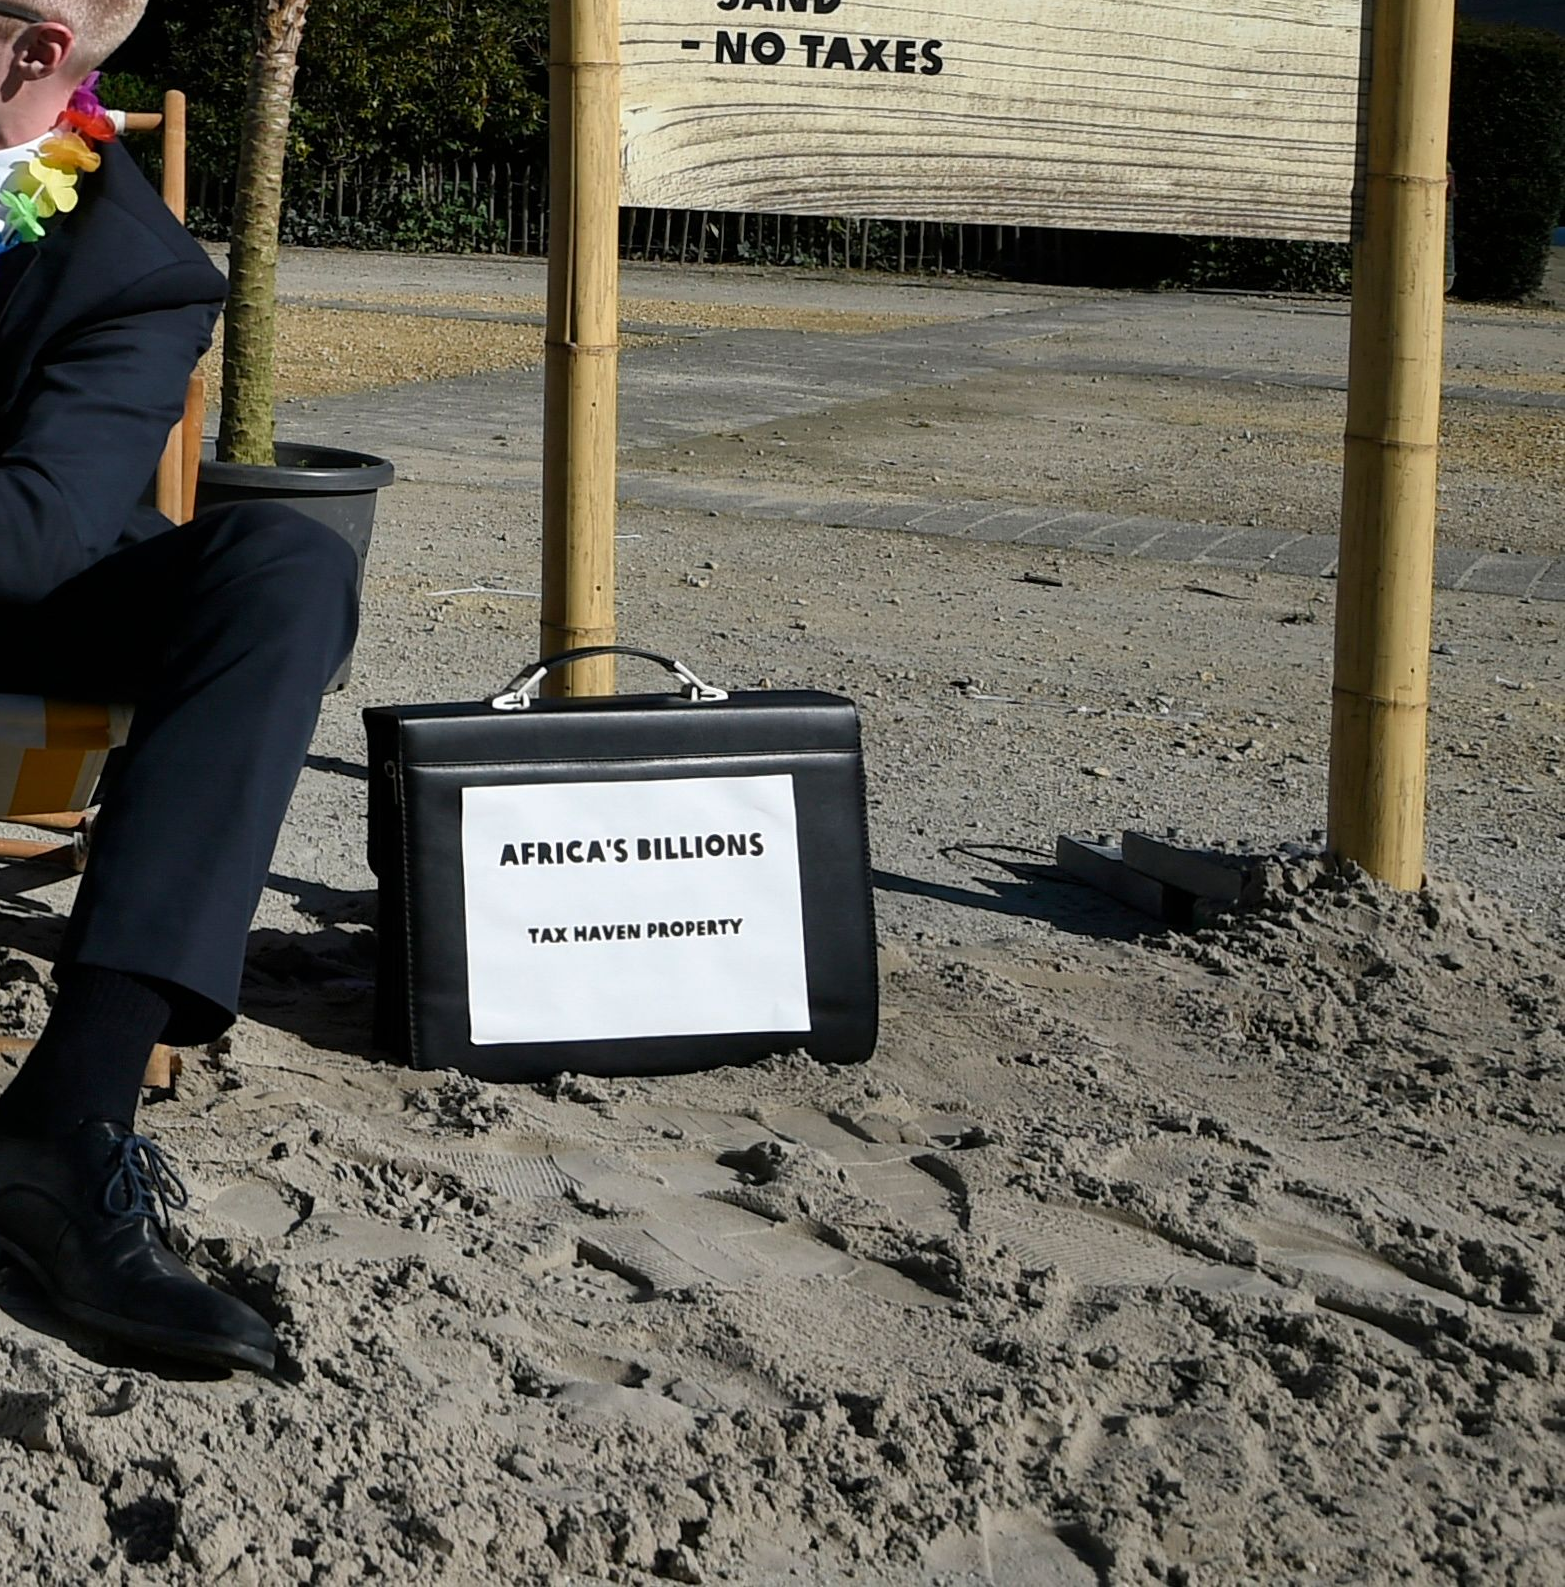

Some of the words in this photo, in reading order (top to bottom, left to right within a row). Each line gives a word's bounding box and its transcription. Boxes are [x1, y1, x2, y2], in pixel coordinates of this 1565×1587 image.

[716, 31, 785, 65] NO
[800, 35, 942, 75] TAXES
[500, 839, 627, 865] AFRICA'S
[638, 833, 763, 860] BILLIONS
[529, 928, 567, 943] TAX
[575, 925, 640, 941] HAVEN
[648, 919, 742, 938] PROPERTY
